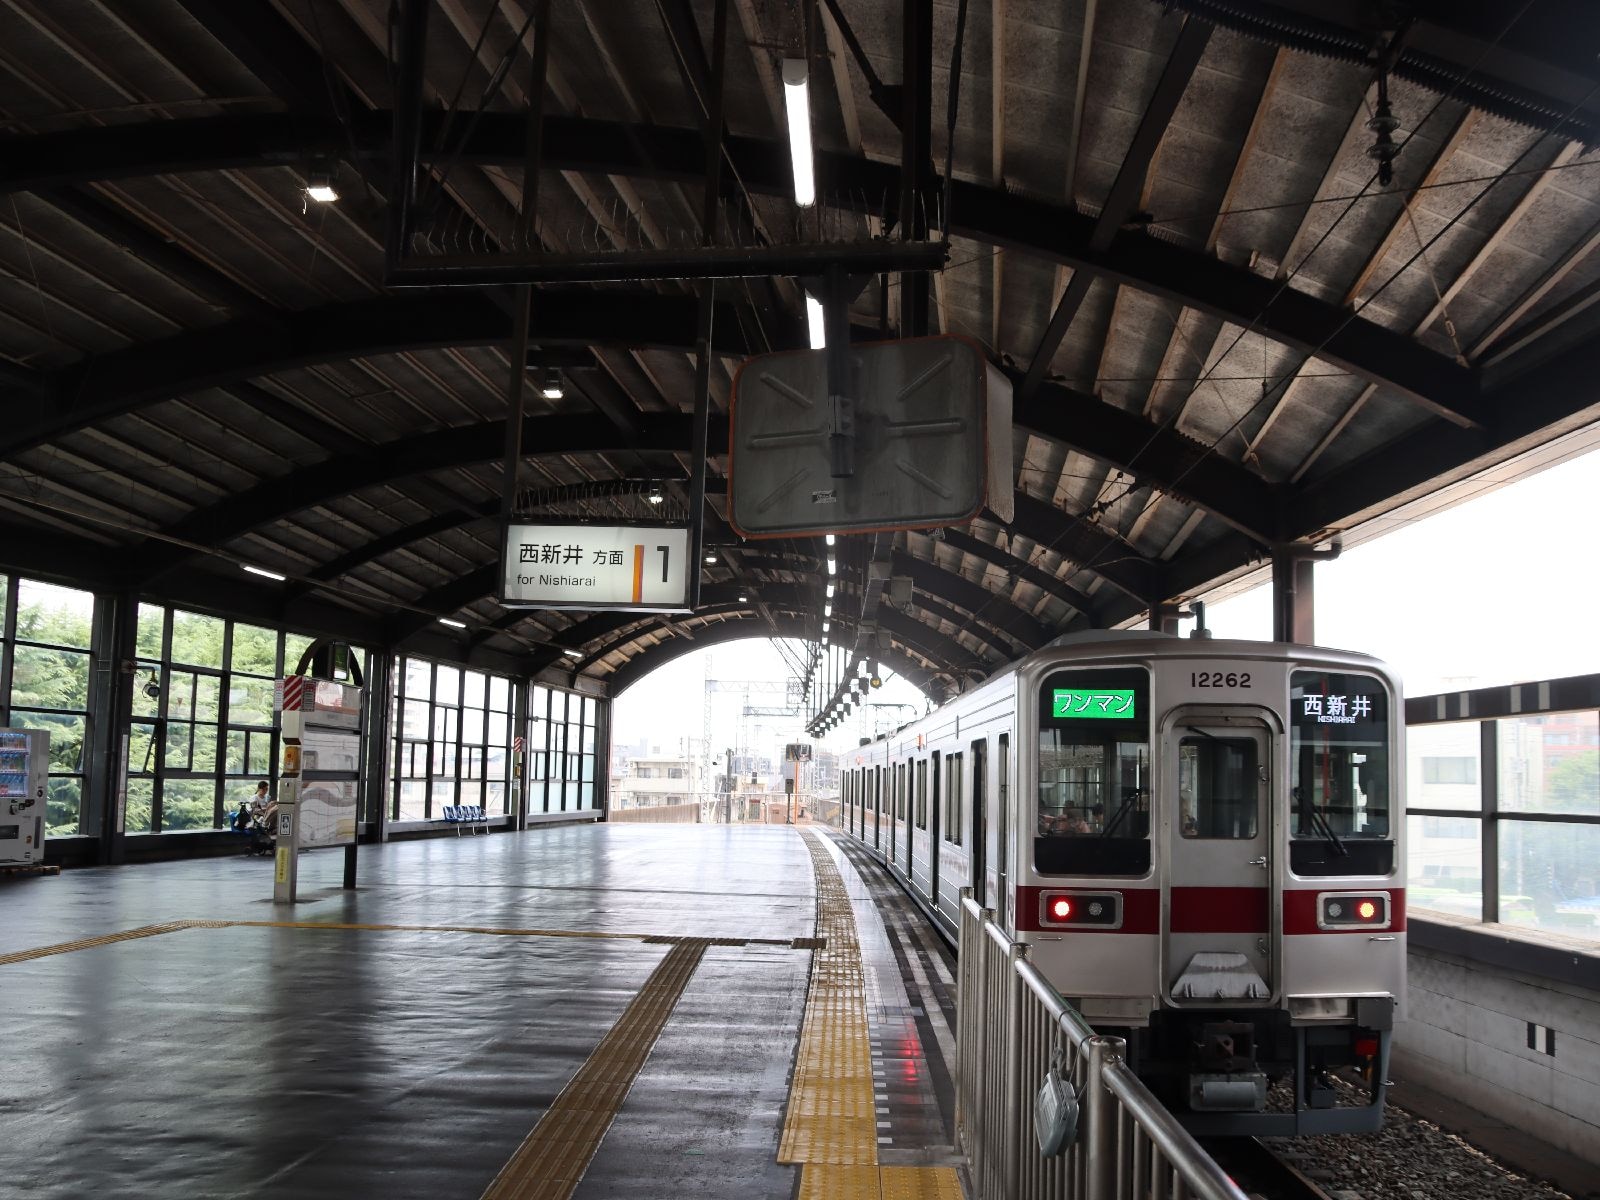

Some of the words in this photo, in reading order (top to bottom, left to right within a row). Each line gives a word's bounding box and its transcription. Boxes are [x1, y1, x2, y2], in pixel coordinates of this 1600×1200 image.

[519, 543, 583, 565] 西新井
[592, 550, 624, 566] 方面
[656, 545, 670, 583] 1
[517, 574, 534, 585] for
[539, 574, 596, 587] Nishiarai
[1191, 672, 1251, 689] 12262
[1054, 694, 1134, 713] ワンマン
[1303, 694, 1372, 718] 西新井
[1317, 715, 1356, 724] NISHIARAI
